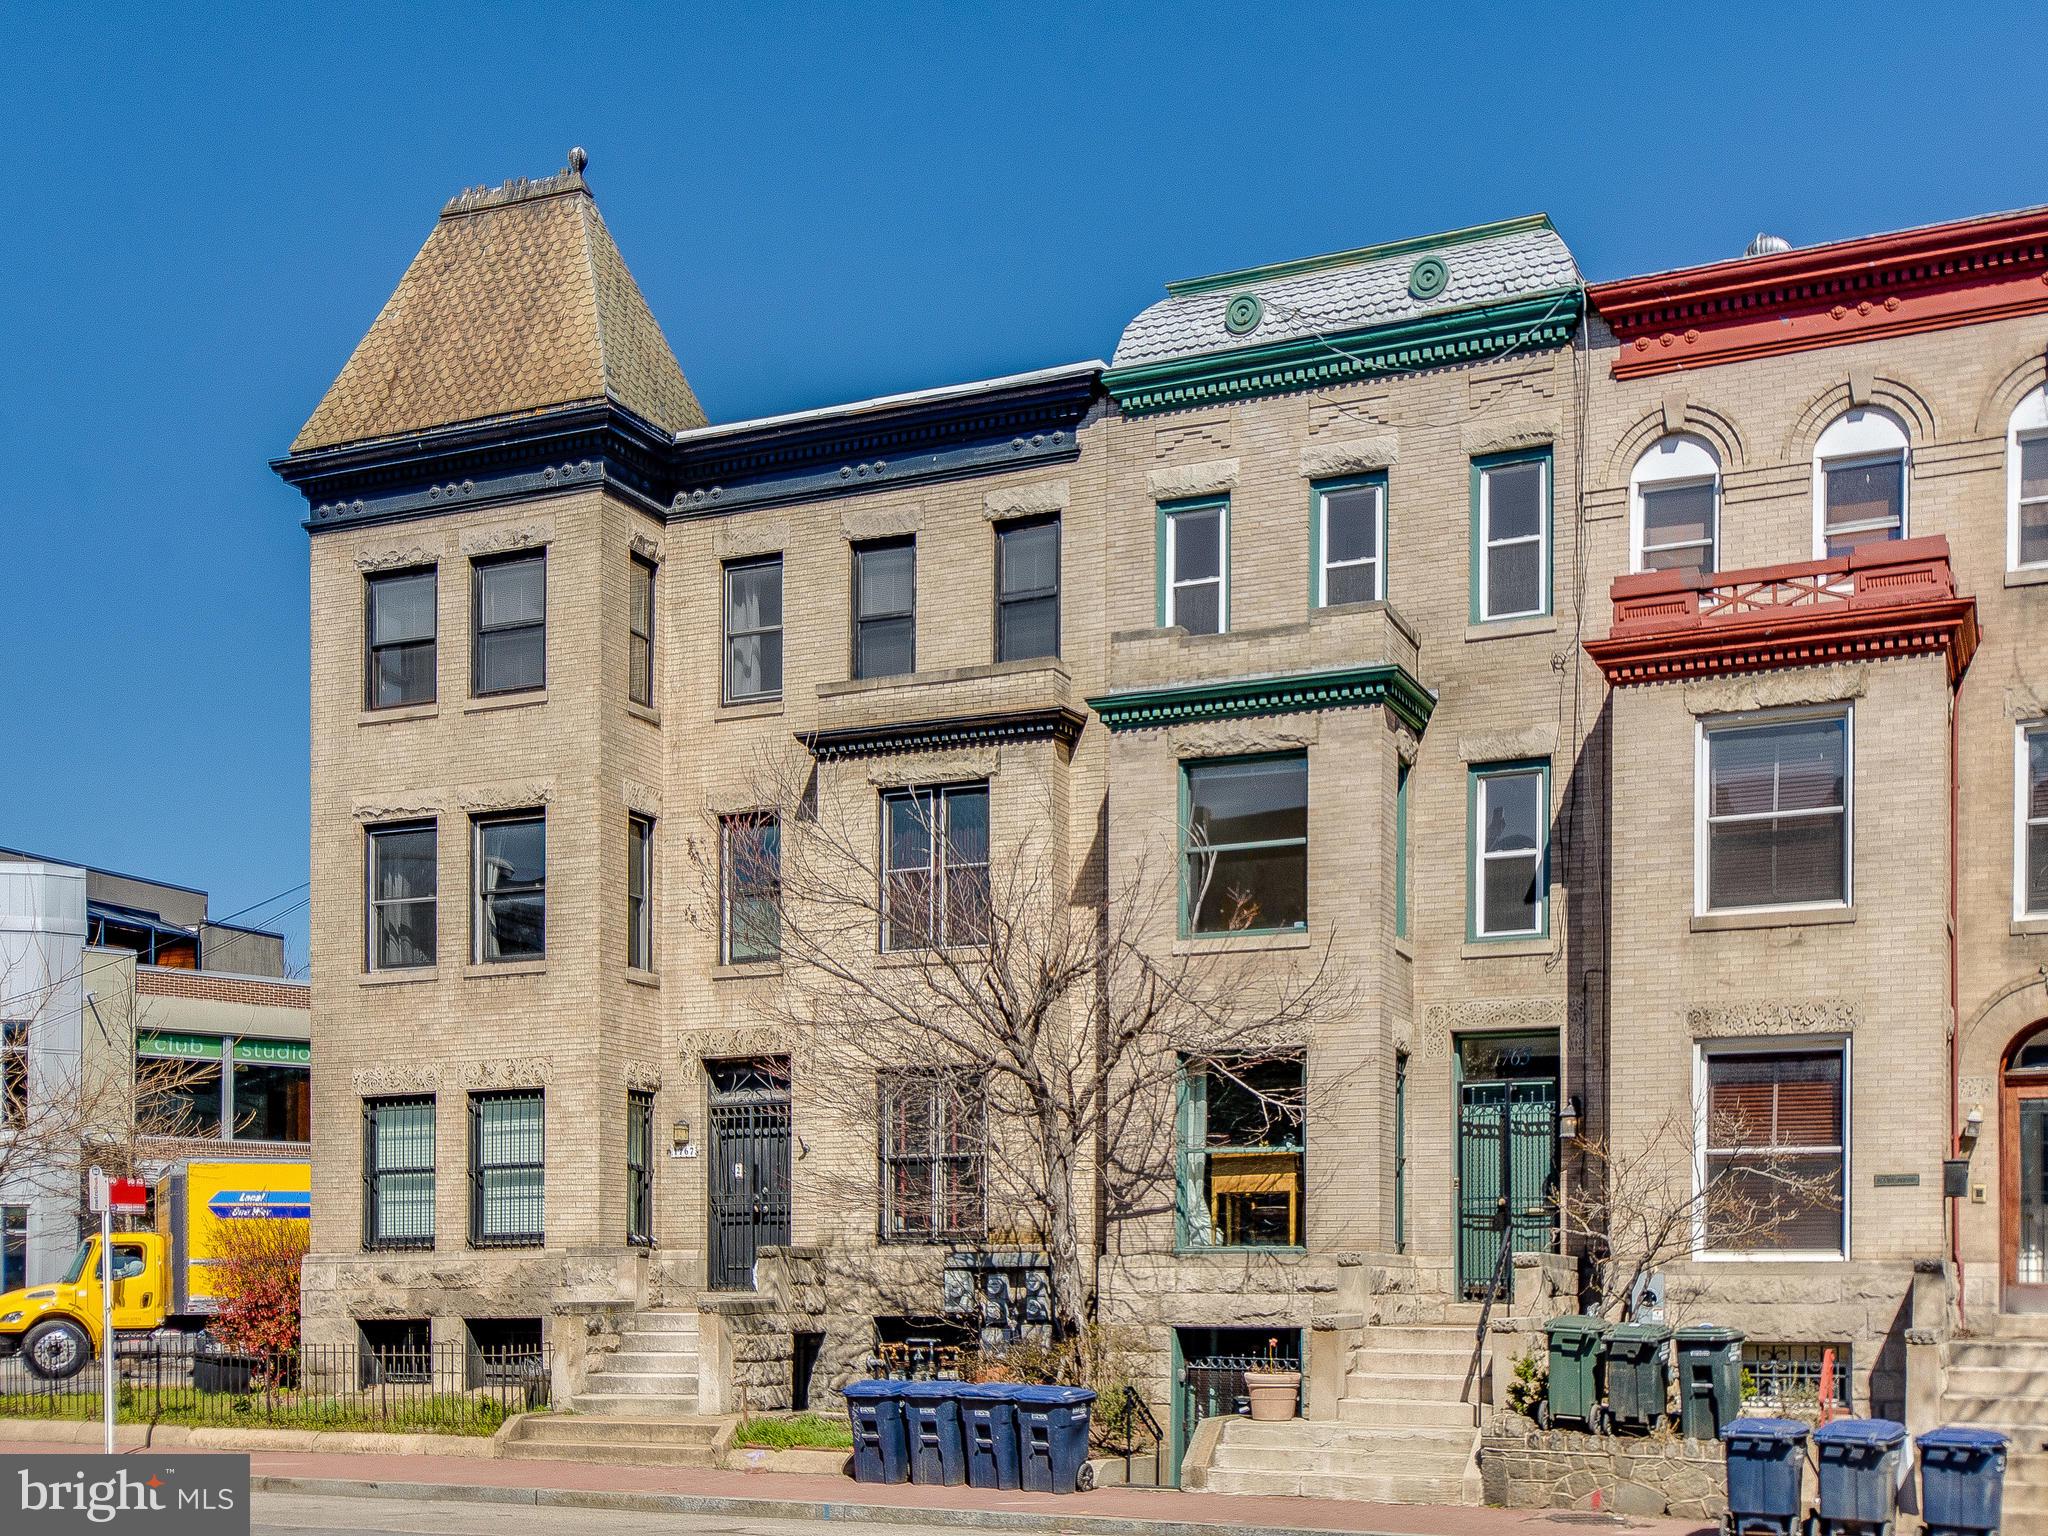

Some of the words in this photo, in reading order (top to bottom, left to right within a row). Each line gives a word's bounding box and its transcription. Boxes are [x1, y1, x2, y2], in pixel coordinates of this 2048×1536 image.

[154, 1035, 203, 1053] club
[241, 1043, 311, 1061] studio
[239, 1192, 266, 1202] Local
